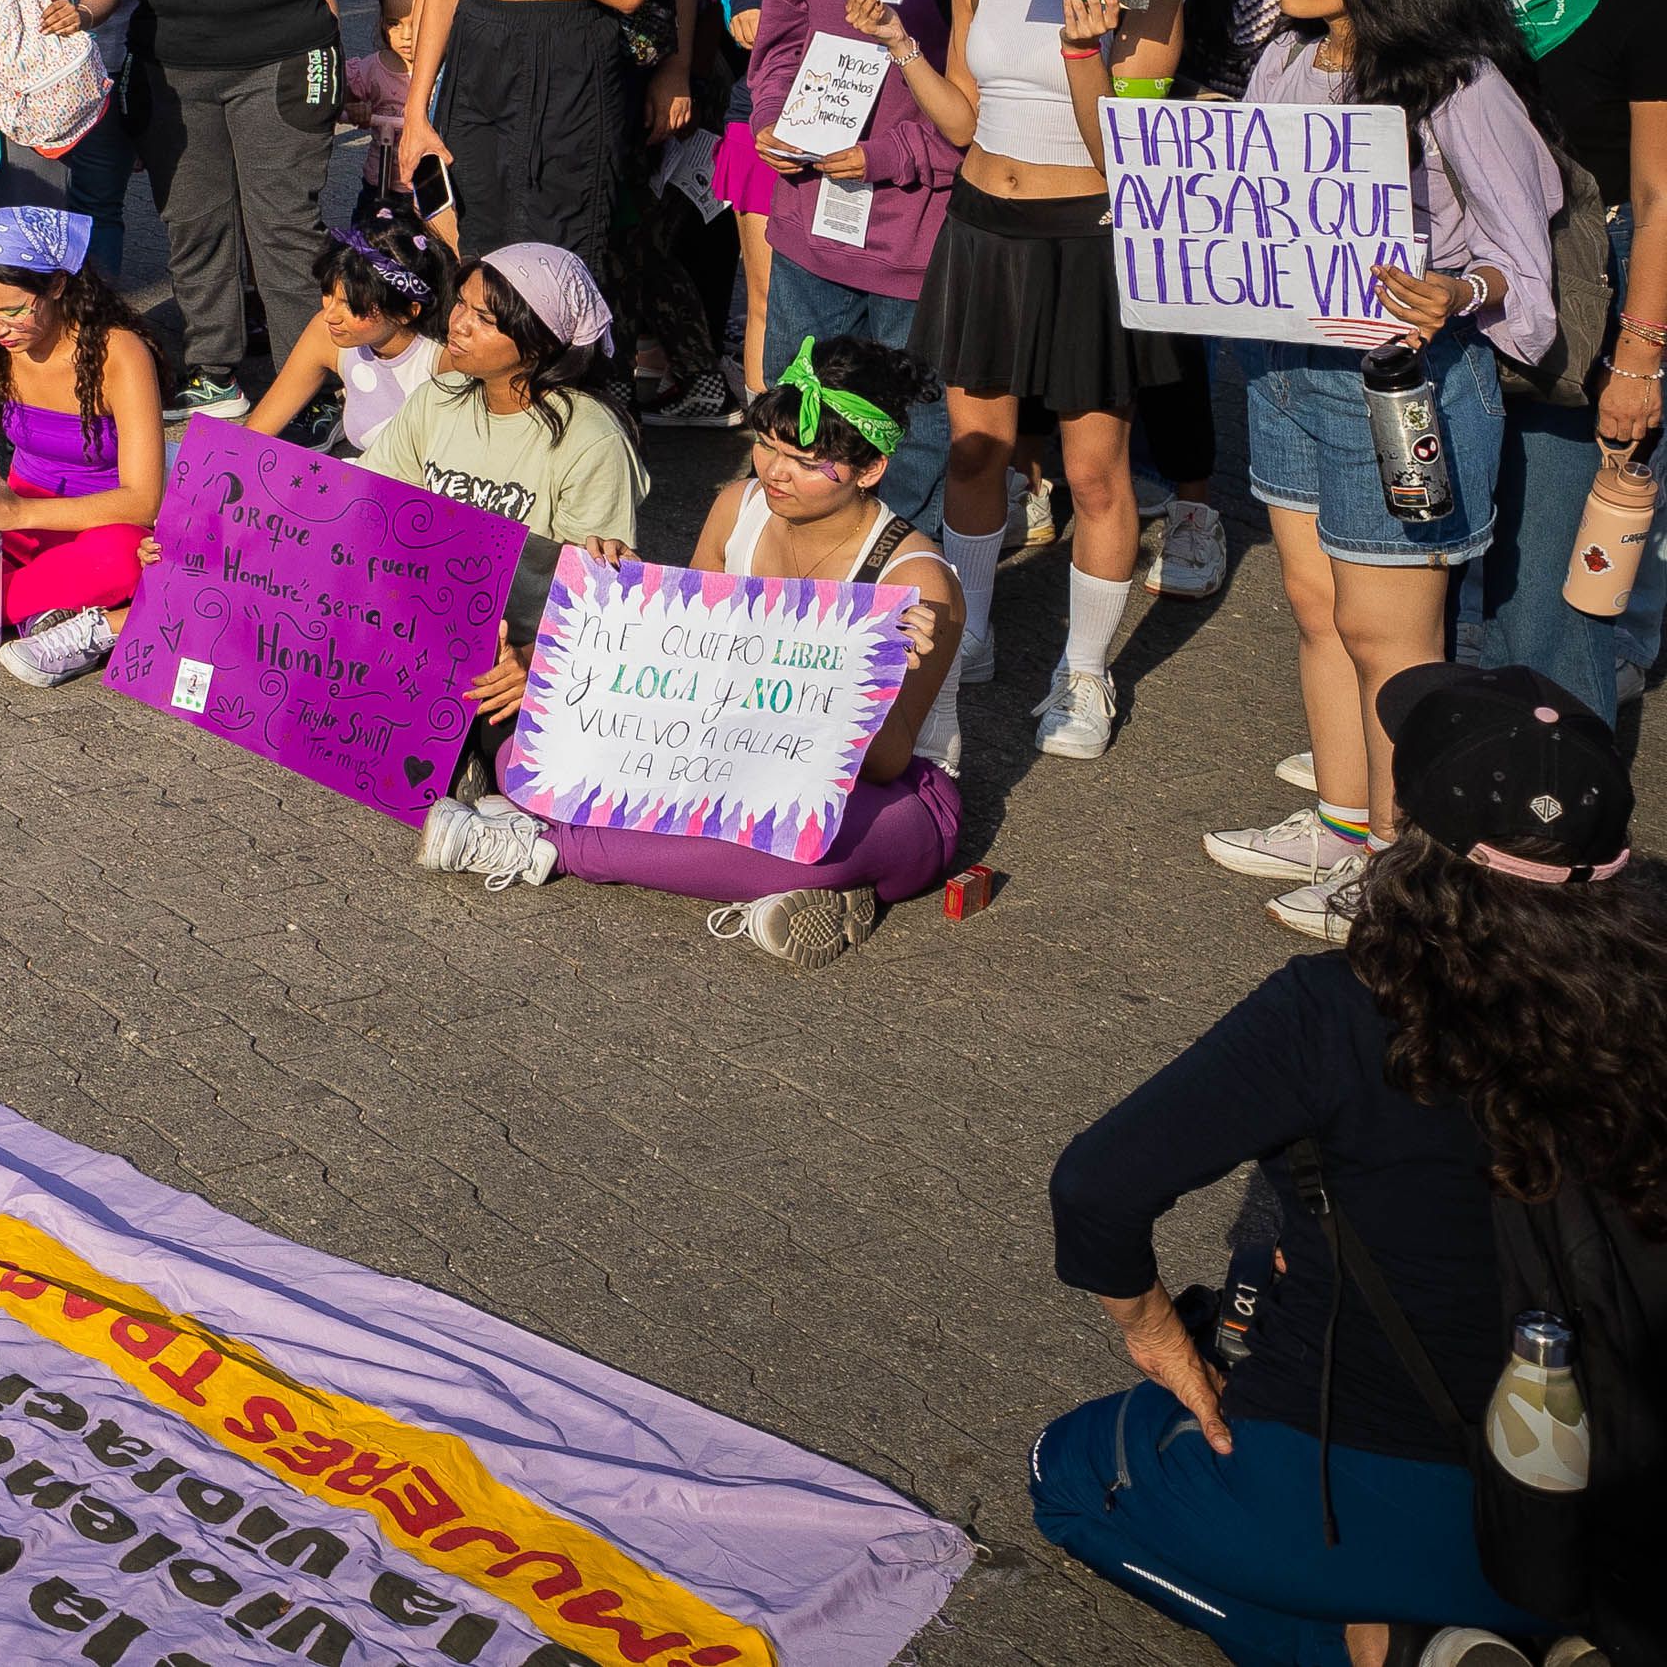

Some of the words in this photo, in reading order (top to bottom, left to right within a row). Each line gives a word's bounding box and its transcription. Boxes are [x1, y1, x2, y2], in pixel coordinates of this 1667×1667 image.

[1107, 106, 1279, 172] HARTA
[1304, 112, 1373, 173] DE
[1115, 173, 1301, 239] AVISAR
[1308, 176, 1409, 240] QUE
[1125, 237, 1297, 309] LLEGUÉ
[868, 518, 912, 570] BRITTO
[368, 556, 431, 586] fuera
[393, 615, 418, 644] el
[661, 625, 765, 665] QUIERO
[772, 639, 848, 671] LIBRE
[608, 663, 700, 702] LOCA
[740, 677, 793, 714] NO
[578, 705, 691, 749] VUELVO
[700, 726, 720, 749] A
[722, 726, 815, 764] CALLAR
[619, 750, 655, 779] LA
[669, 756, 734, 783] BOCA
